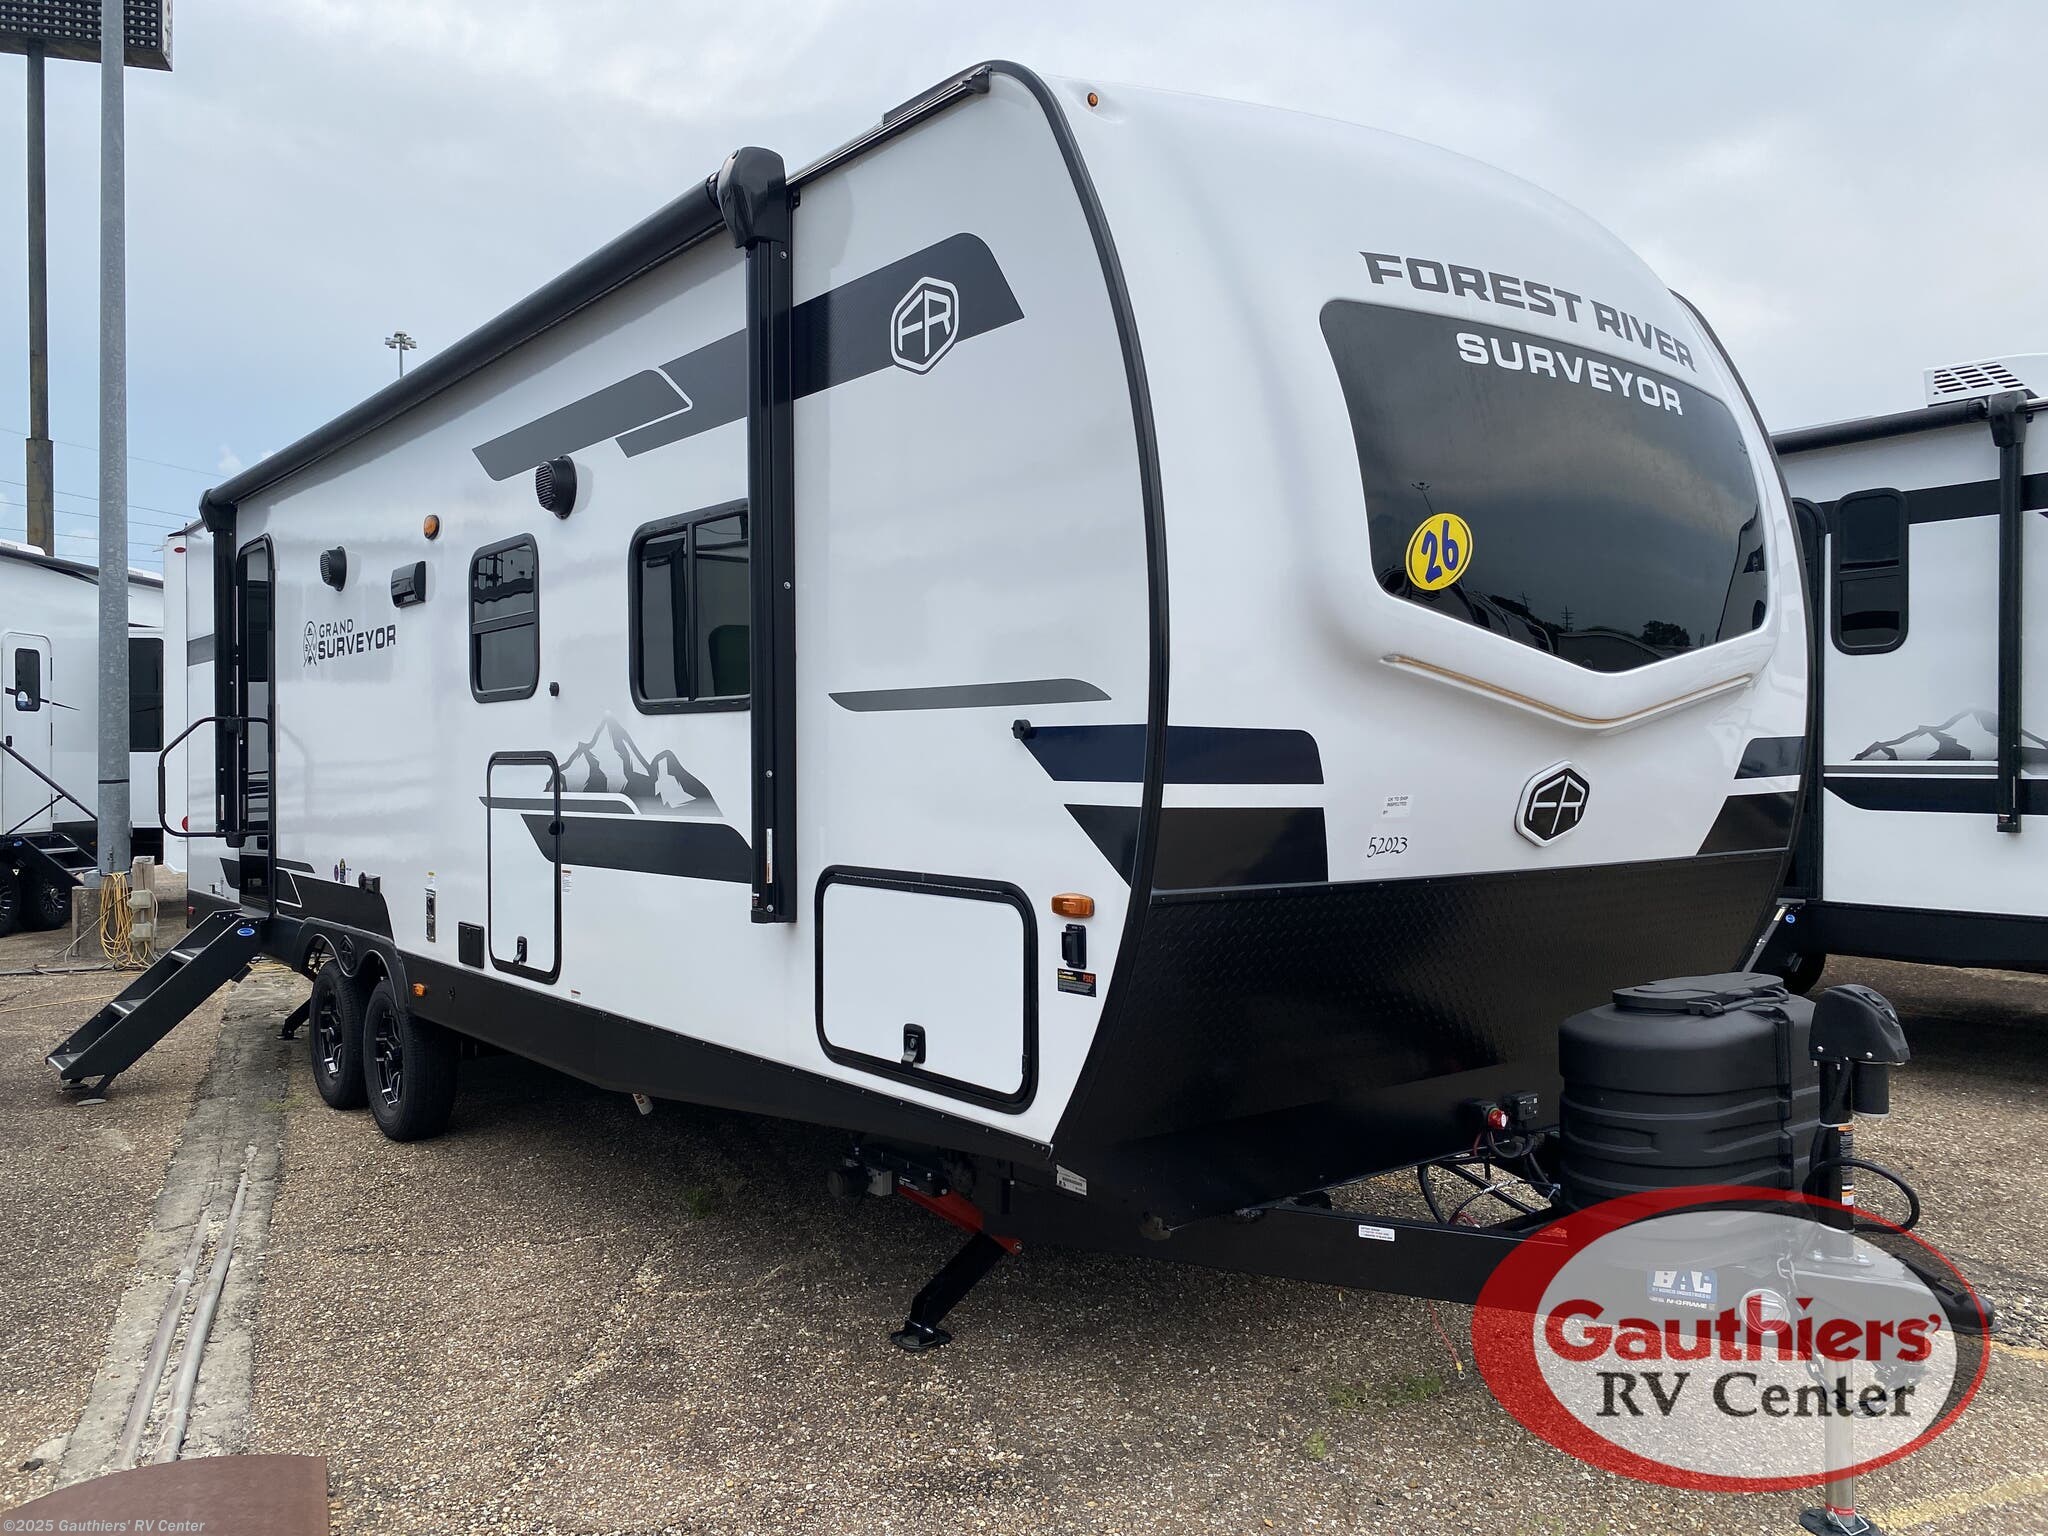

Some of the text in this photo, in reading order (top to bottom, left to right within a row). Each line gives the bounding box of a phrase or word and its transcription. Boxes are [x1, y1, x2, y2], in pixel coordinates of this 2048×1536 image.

[1358, 250, 1697, 374] FOREST RIVER
[1455, 331, 1684, 417] SURVEYOR
[1421, 518, 1460, 584] 26
[318, 624, 396, 660] SURVEYOR
[319, 619, 354, 638] GRAND
[1366, 836, 1408, 858] 52023
[1653, 1270, 1712, 1293] BAL
